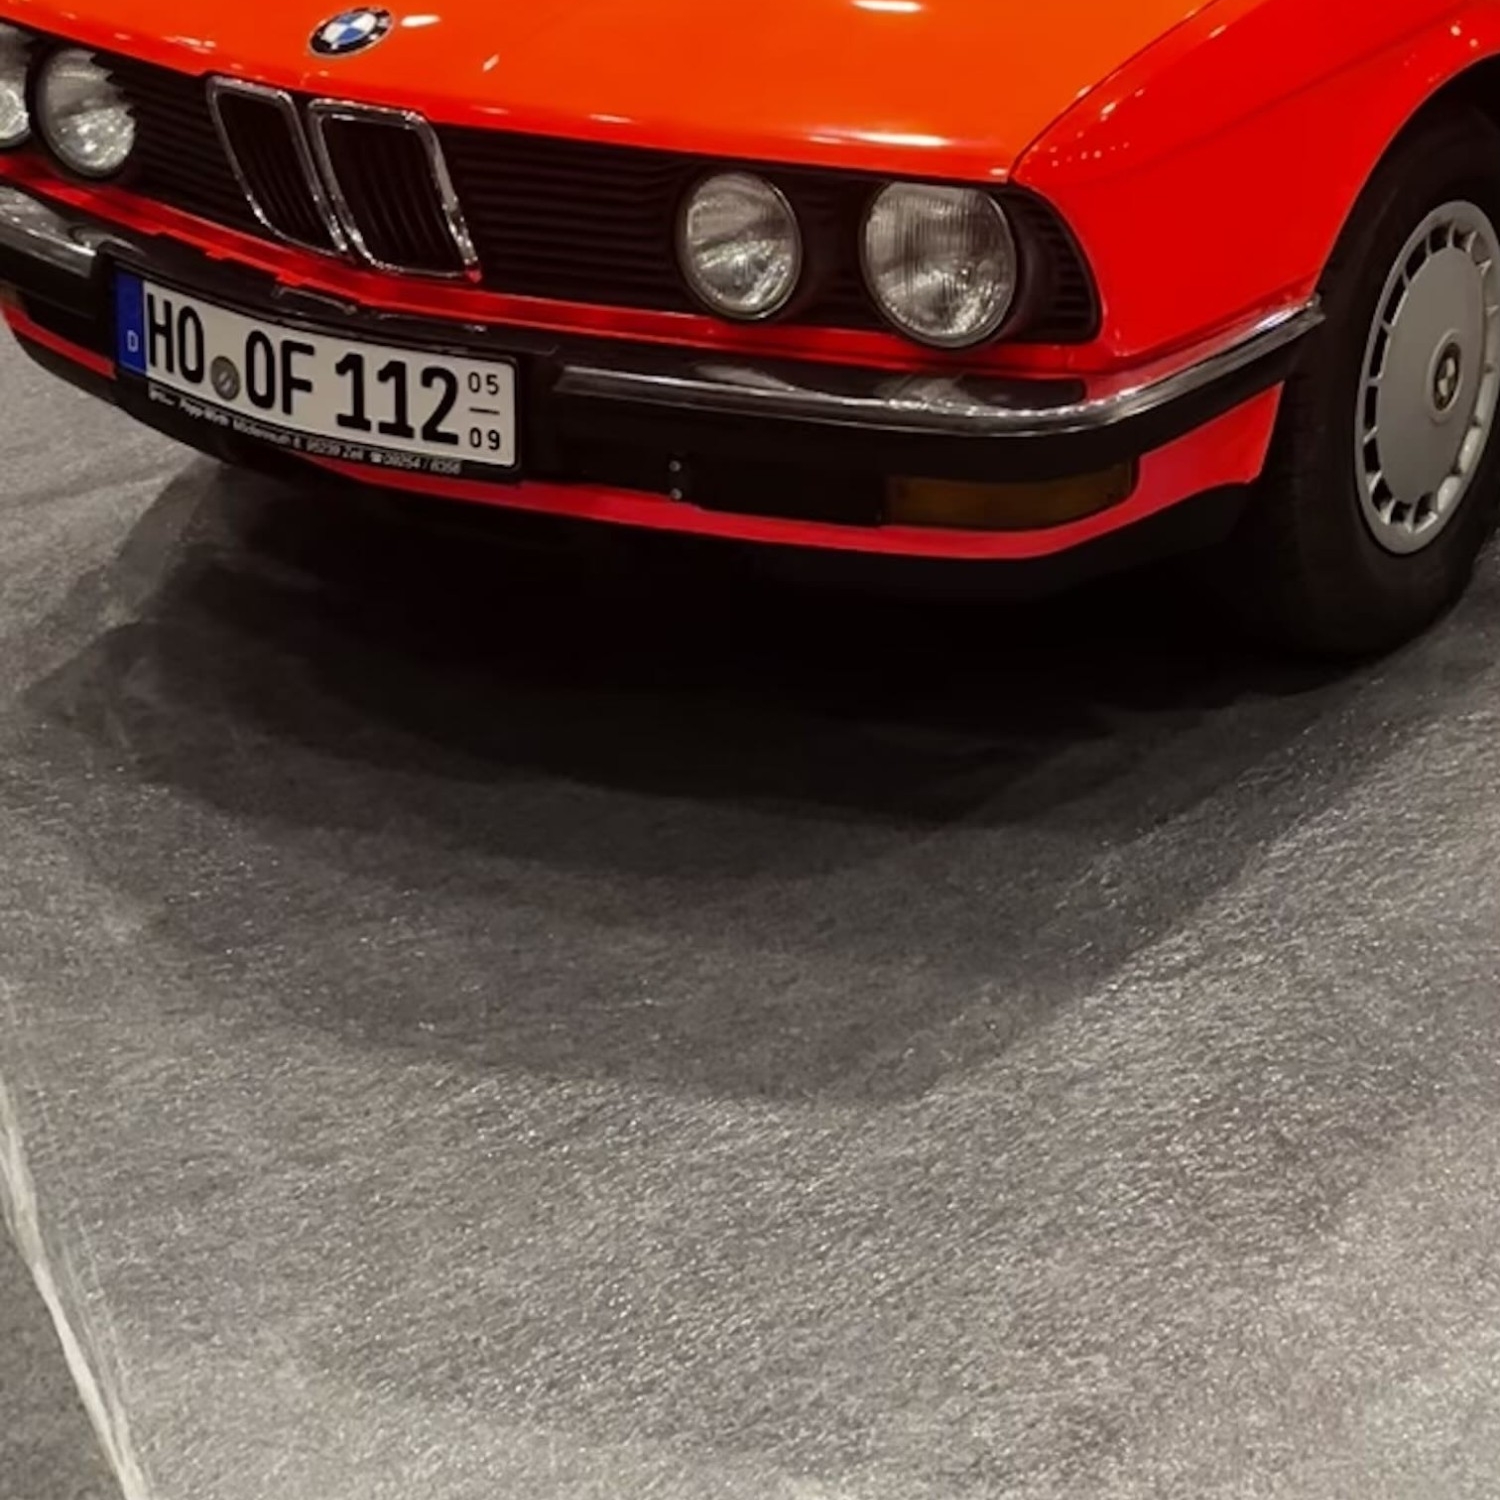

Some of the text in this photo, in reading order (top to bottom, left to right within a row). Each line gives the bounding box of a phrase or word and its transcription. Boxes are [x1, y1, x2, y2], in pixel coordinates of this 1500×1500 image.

[126, 329, 139, 353] D
[146, 293, 206, 385] HO
[244, 329, 315, 416] OF
[334, 352, 460, 445] 112
[468, 371, 500, 397] 05
[468, 427, 501, 451] 09
